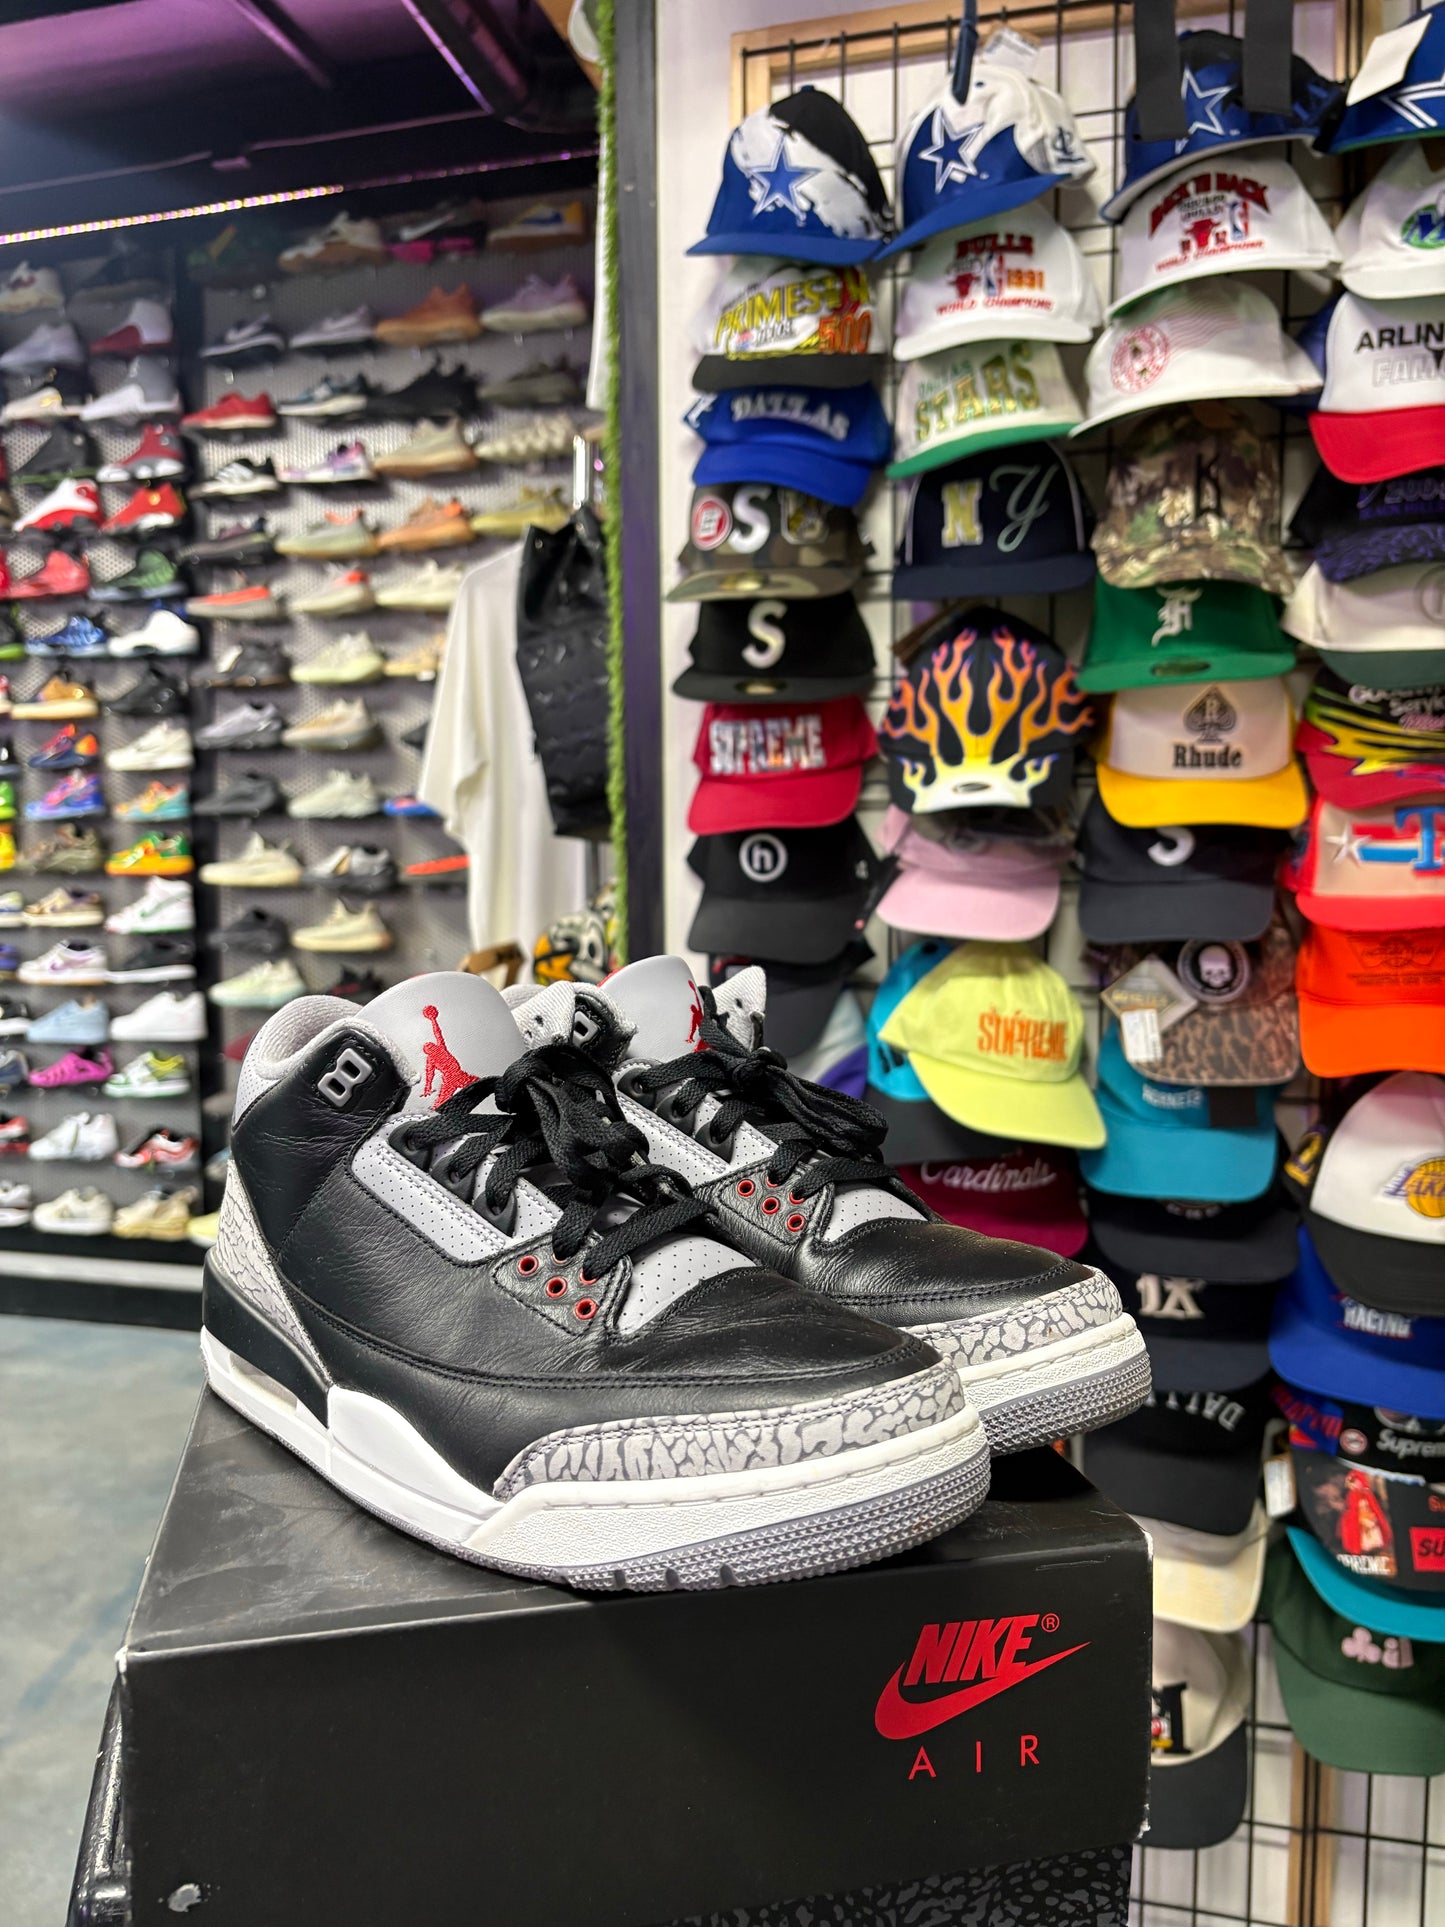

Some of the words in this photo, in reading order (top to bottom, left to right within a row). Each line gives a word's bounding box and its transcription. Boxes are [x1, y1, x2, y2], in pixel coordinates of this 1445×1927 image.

[818, 309, 873, 355] 500
[915, 338, 1041, 441] STARS
[731, 392, 850, 441] DALLAS
[742, 600, 788, 669] S
[1173, 743, 1242, 770] Rhude
[919, 1157, 1058, 1193] Cardinals
[902, 1614, 1041, 1687] NIKE
[908, 1734, 1041, 1781] AIR
